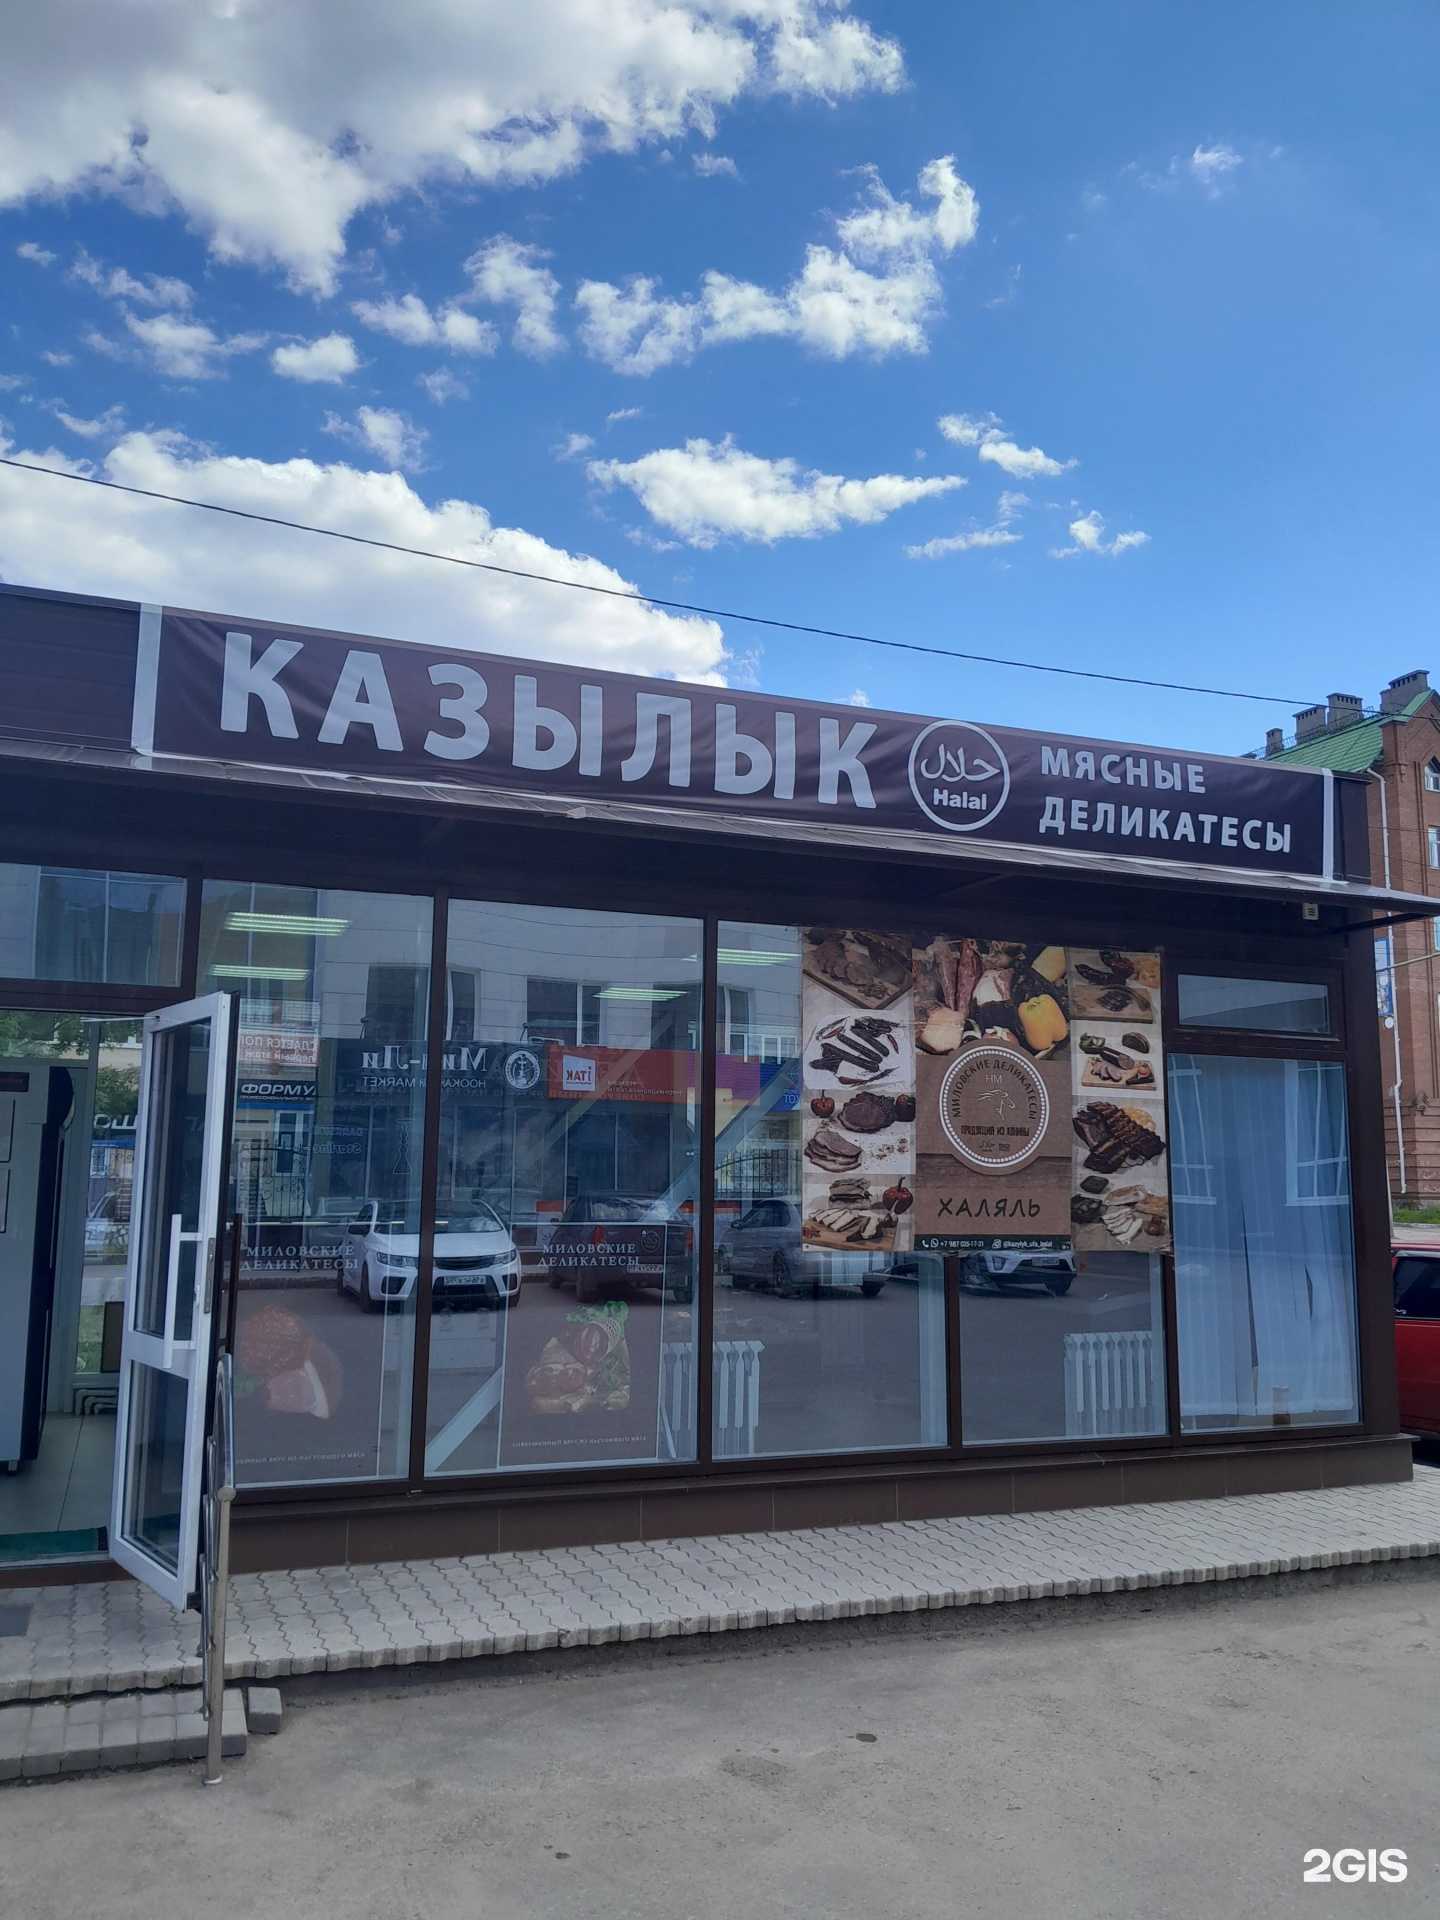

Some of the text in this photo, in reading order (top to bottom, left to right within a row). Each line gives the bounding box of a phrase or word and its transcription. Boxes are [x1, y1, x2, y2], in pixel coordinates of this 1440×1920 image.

[219, 631, 878, 809] КАЗЫЛЫК
[920, 743, 1000, 782] حلال
[1040, 745, 1207, 794] МЯСНЫЕ
[933, 788, 988, 811] Halal
[1038, 796, 1292, 854] ДЕЛИКАТЕСЫ
[951, 1059, 1038, 1120] МИЛОВСКИЕ ДЕЛИКАТЕСЫ
[937, 1198, 1041, 1218] ХАЛЯЛЬ
[246, 1245, 355, 1258] МИЛОВСКИЕ
[543, 1243, 637, 1255] МИЛОВСКИЕ
[239, 1258, 360, 1271] ДЕЛИКАТЕСЫ
[536, 1256, 641, 1268] ДЕЛИКАТЕСЫ
